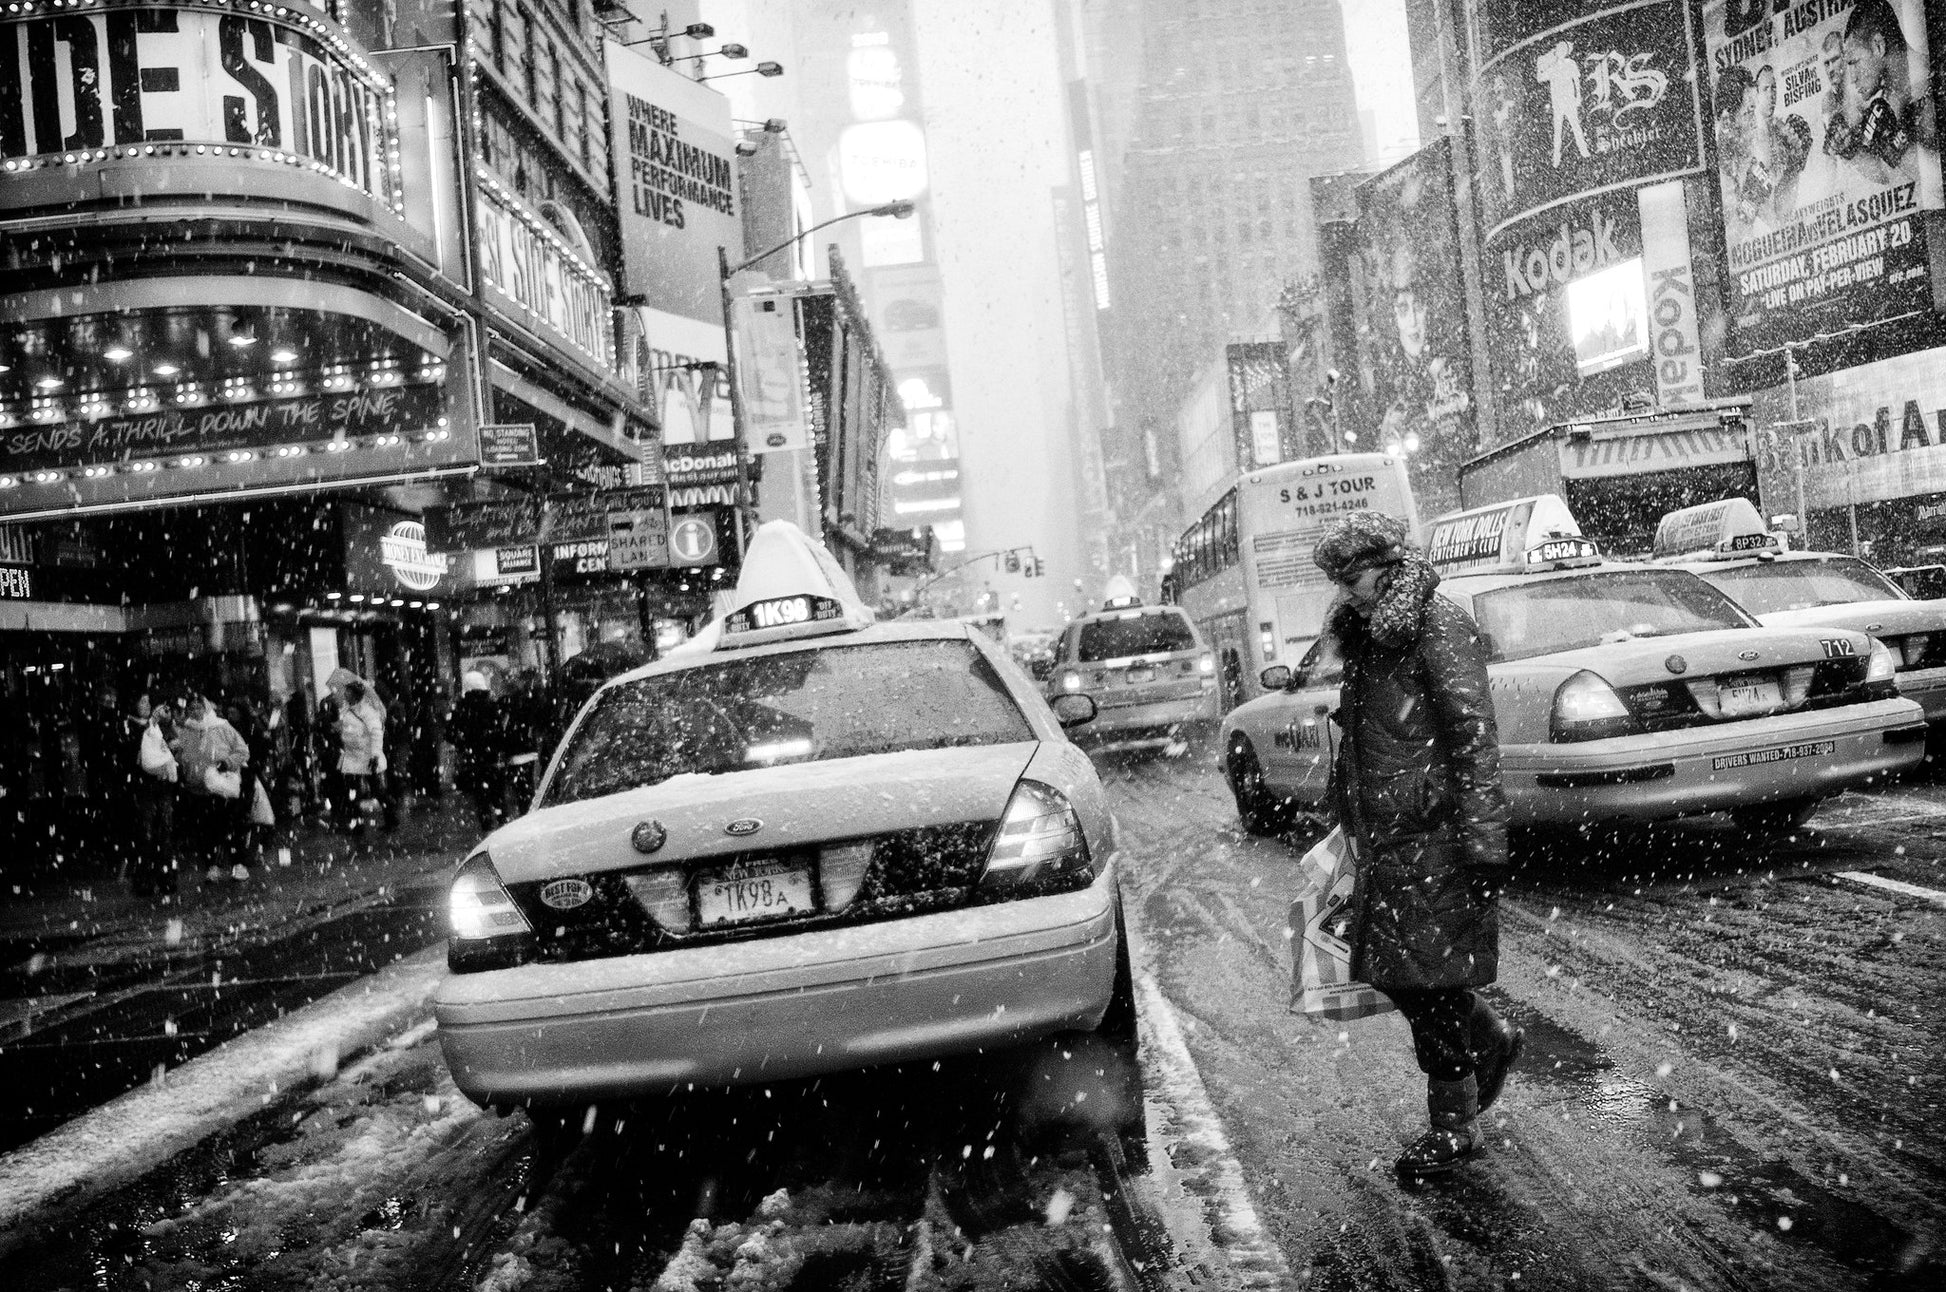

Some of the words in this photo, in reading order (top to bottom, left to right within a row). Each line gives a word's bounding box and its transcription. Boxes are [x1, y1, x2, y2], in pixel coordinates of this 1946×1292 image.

[627, 93, 678, 136] WHERE
[628, 118, 732, 193] MAXIMUM
[631, 156, 735, 216] PERFORMANCE
[633, 183, 685, 229] LIVES
[1817, 182, 1917, 236] VELASQUEZ
[1504, 209, 1622, 300] Kodak
[1813, 228, 1887, 273] FEBRUARY
[1890, 220, 1912, 248] 20
[1764, 288, 1787, 309] LIVE
[1789, 282, 1804, 302] ON
[7, 422, 82, 454] SENDS
[88, 423, 107, 450] A
[112, 417, 196, 443] THRILL
[199, 405, 269, 434] DOWN
[277, 400, 321, 425] THE
[1851, 406, 1890, 457] of
[1280, 489, 1291, 503] S
[1296, 487, 1309, 500] &
[1314, 484, 1323, 498] J
[1329, 477, 1375, 495] TOUR
[1475, 512, 1507, 541] DOLLS
[499, 548, 533, 561] SQUARE
[611, 533, 665, 549] SHARED
[1479, 537, 1500, 553] CLUB
[1544, 541, 1577, 558] 5H24
[1737, 536, 1761, 550] 8P32
[577, 556, 609, 573] CEN
[1822, 639, 1855, 657] 712
[1714, 755, 1748, 770] DRIVERS
